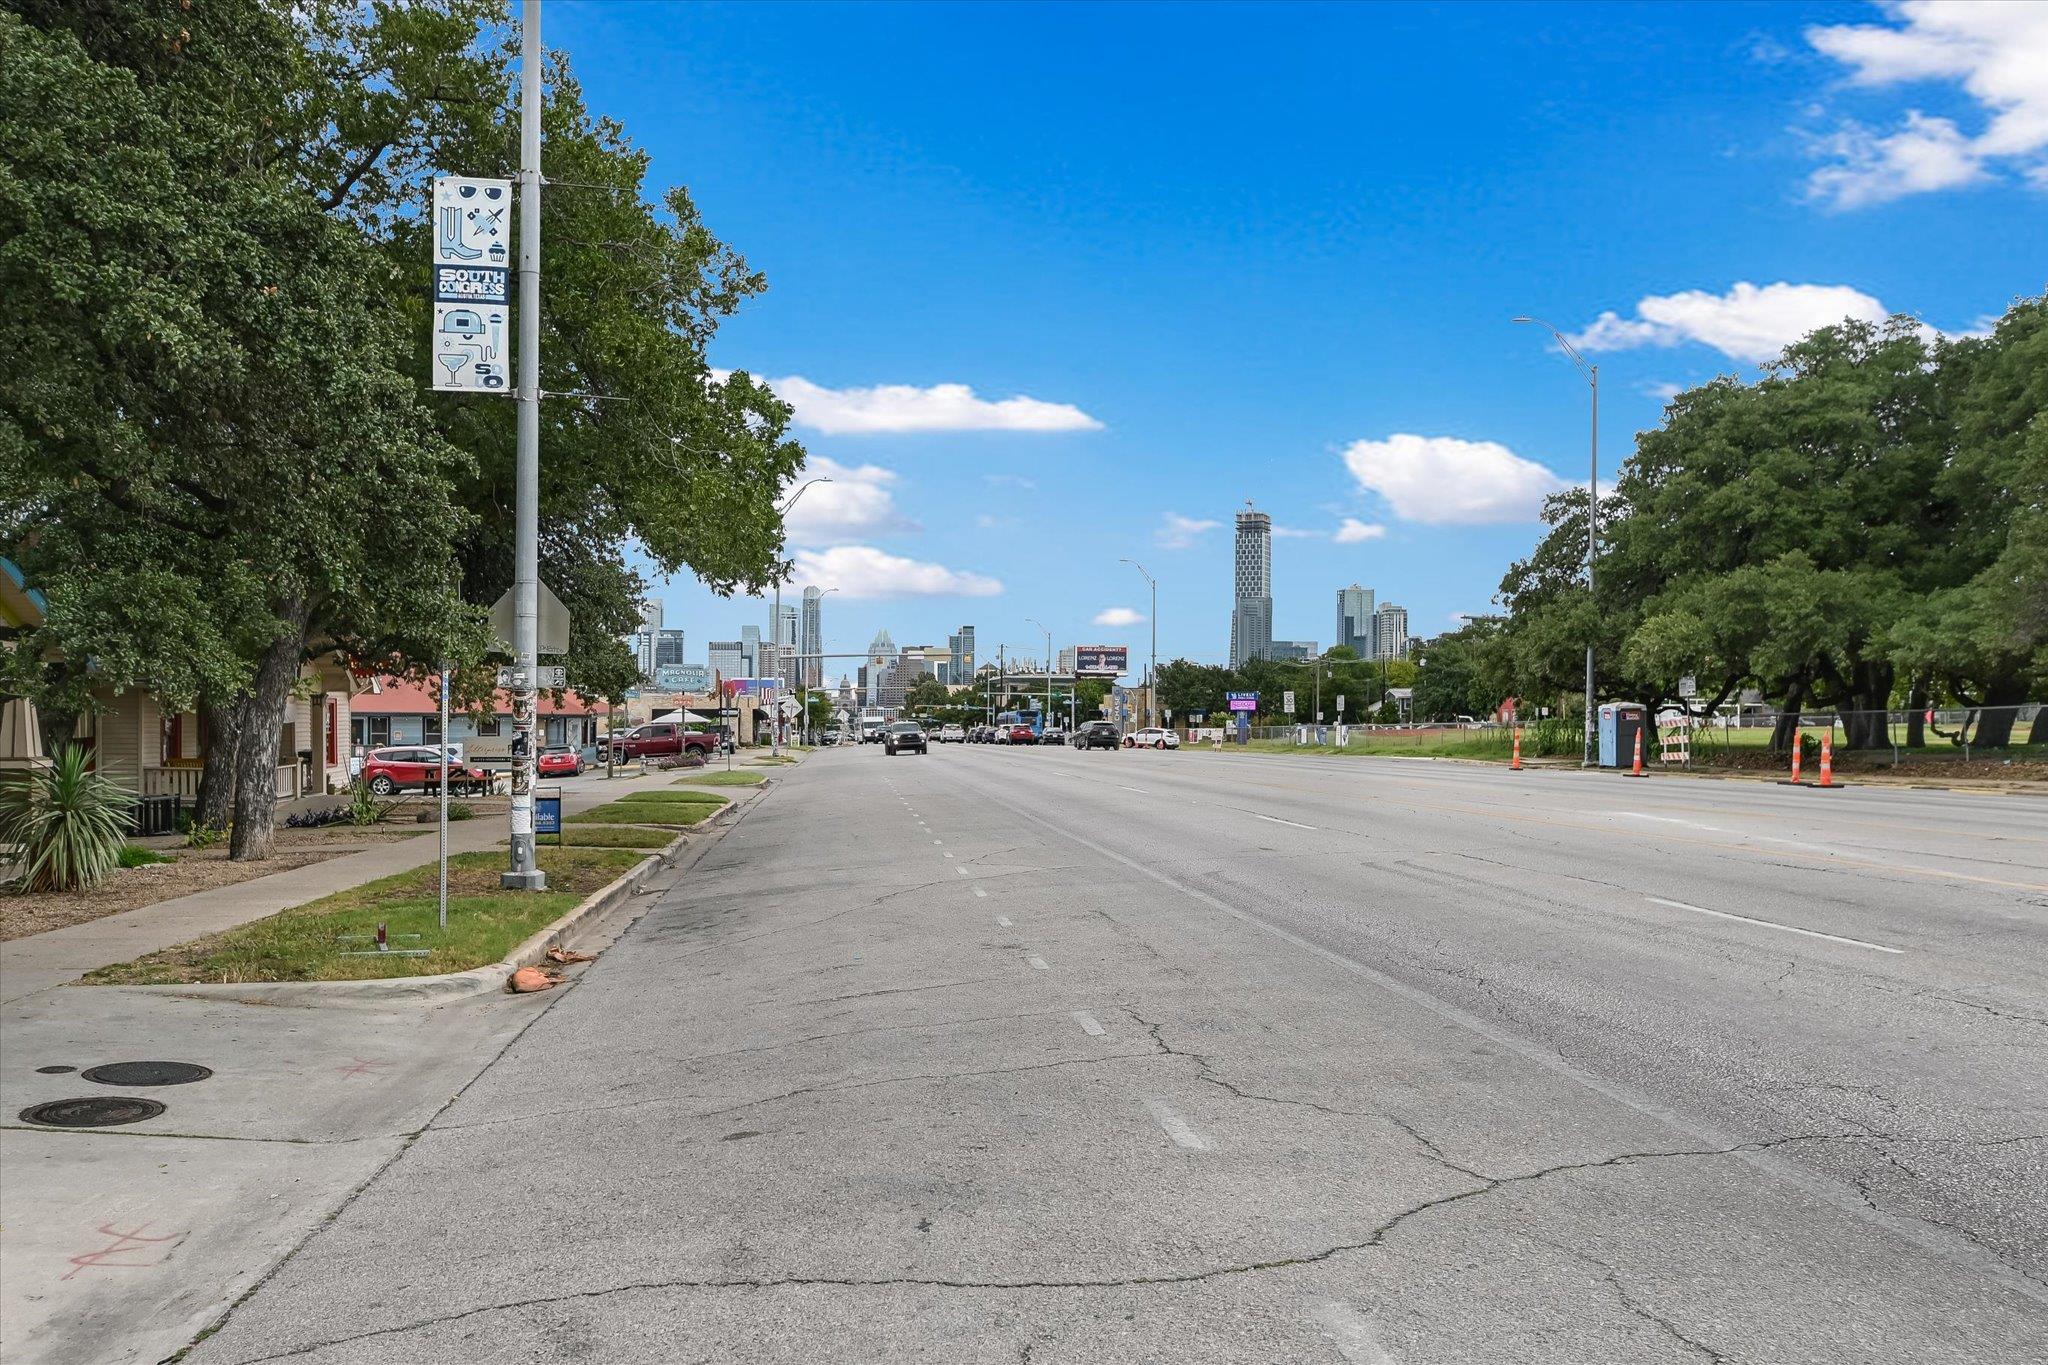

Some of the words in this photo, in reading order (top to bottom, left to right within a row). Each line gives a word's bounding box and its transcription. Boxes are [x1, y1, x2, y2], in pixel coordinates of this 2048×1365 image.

[439, 268, 505, 284] SOUTH
[439, 281, 505, 295] CONGRESS
[663, 669, 705, 677] MAGNOLIA
